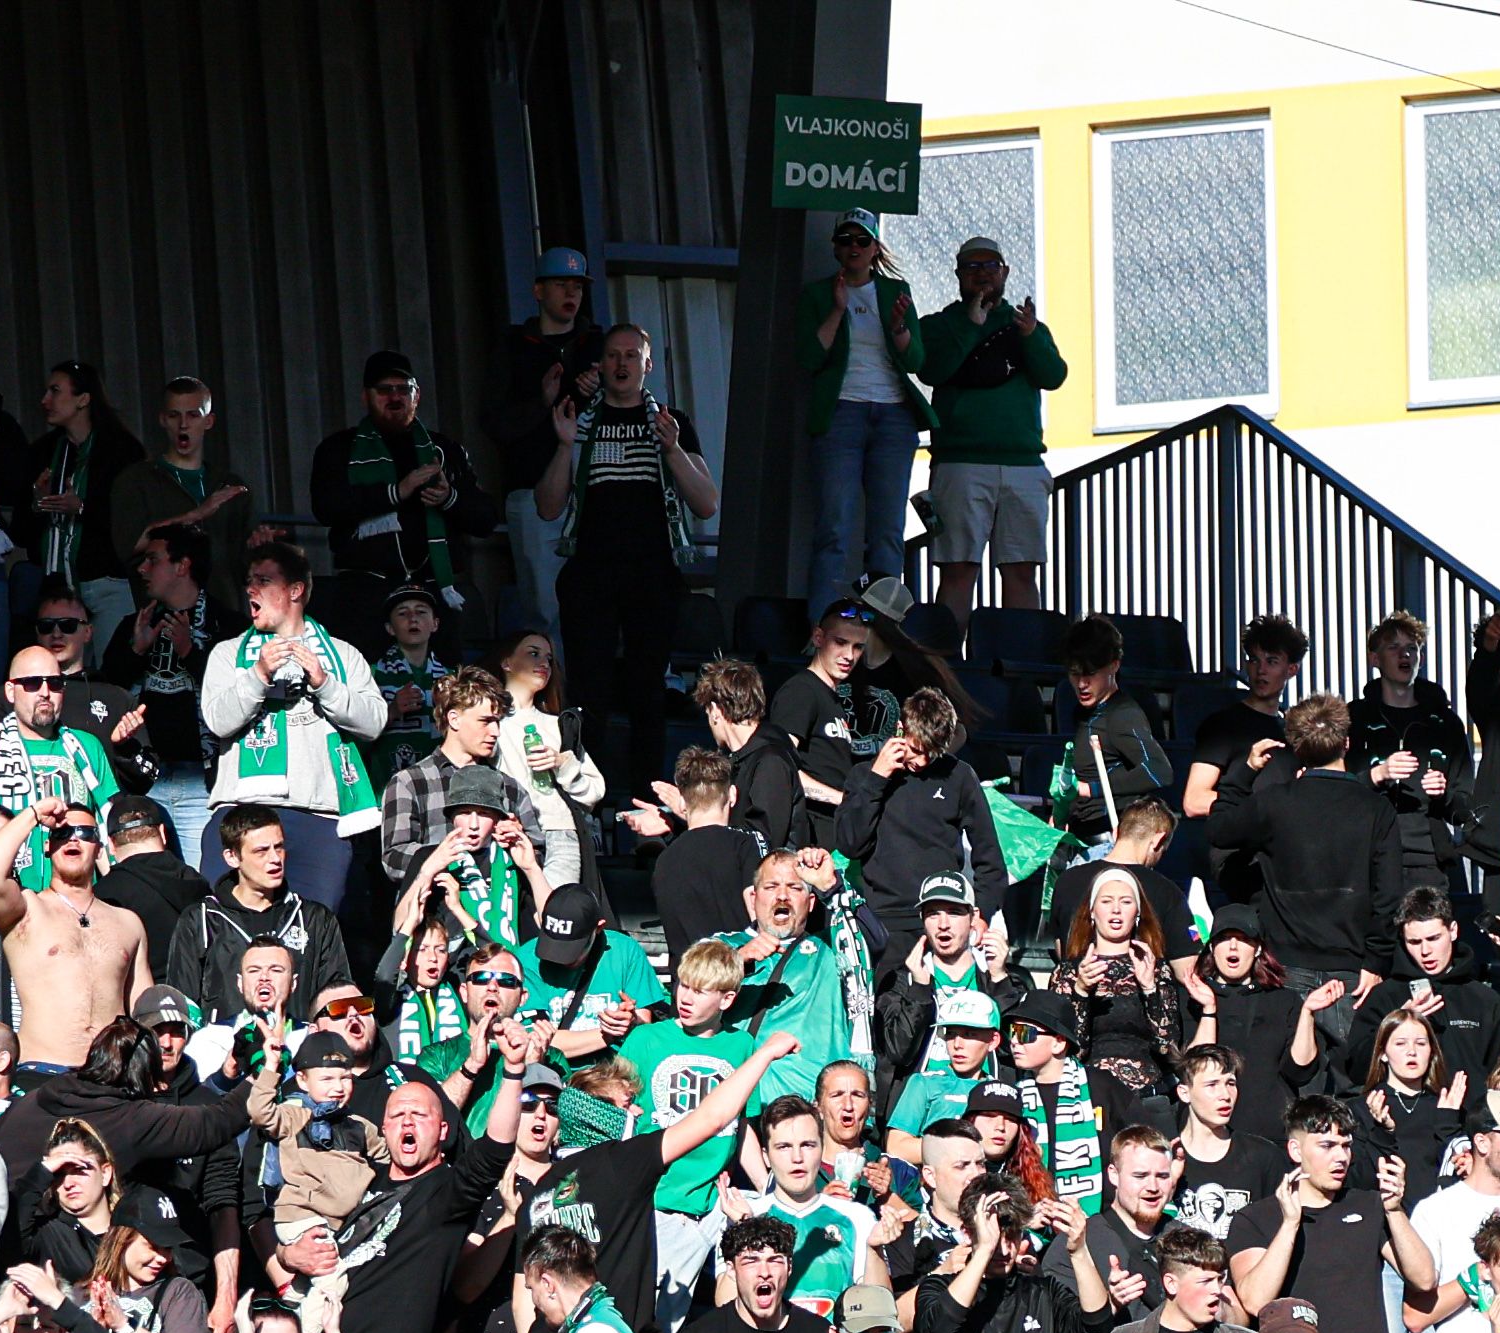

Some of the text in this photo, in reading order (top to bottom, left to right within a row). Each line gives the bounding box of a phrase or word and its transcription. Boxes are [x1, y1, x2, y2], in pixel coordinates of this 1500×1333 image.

[784, 114, 910, 142] VLAJKONOŠI
[784, 159, 908, 194] DOMÁCÍ
[545, 914, 574, 936] FKJ
